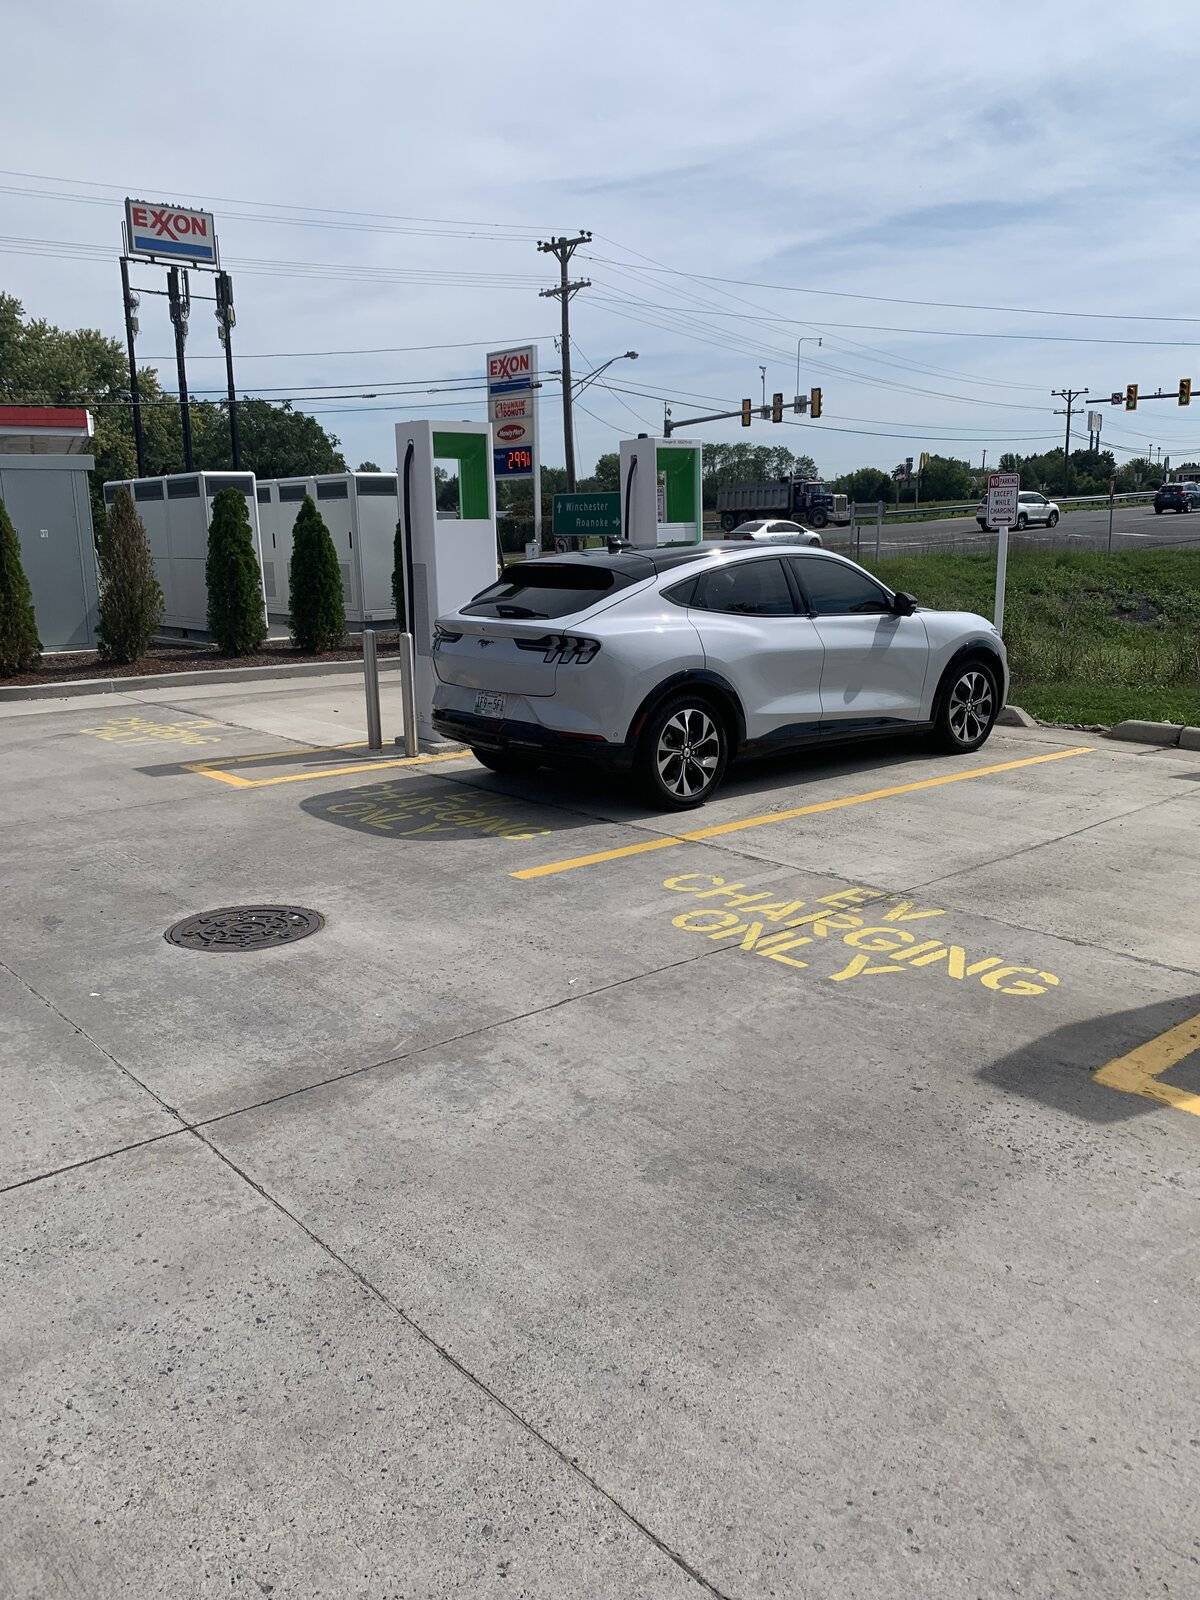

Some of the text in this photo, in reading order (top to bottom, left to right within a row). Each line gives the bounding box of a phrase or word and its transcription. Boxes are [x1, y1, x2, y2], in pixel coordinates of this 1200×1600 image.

[132, 207, 207, 241] EXXON
[490, 354, 529, 379] EXXON
[991, 477, 999, 486] NO
[566, 502, 609, 512] Winchester
[990, 507, 1015, 515] CHARGING
[575, 518, 609, 527] Roanoke
[325, 802, 457, 836] ONLY
[815, 887, 948, 922] EV
[662, 873, 1060, 996] CHARGING
[671, 909, 907, 982] ONLY
